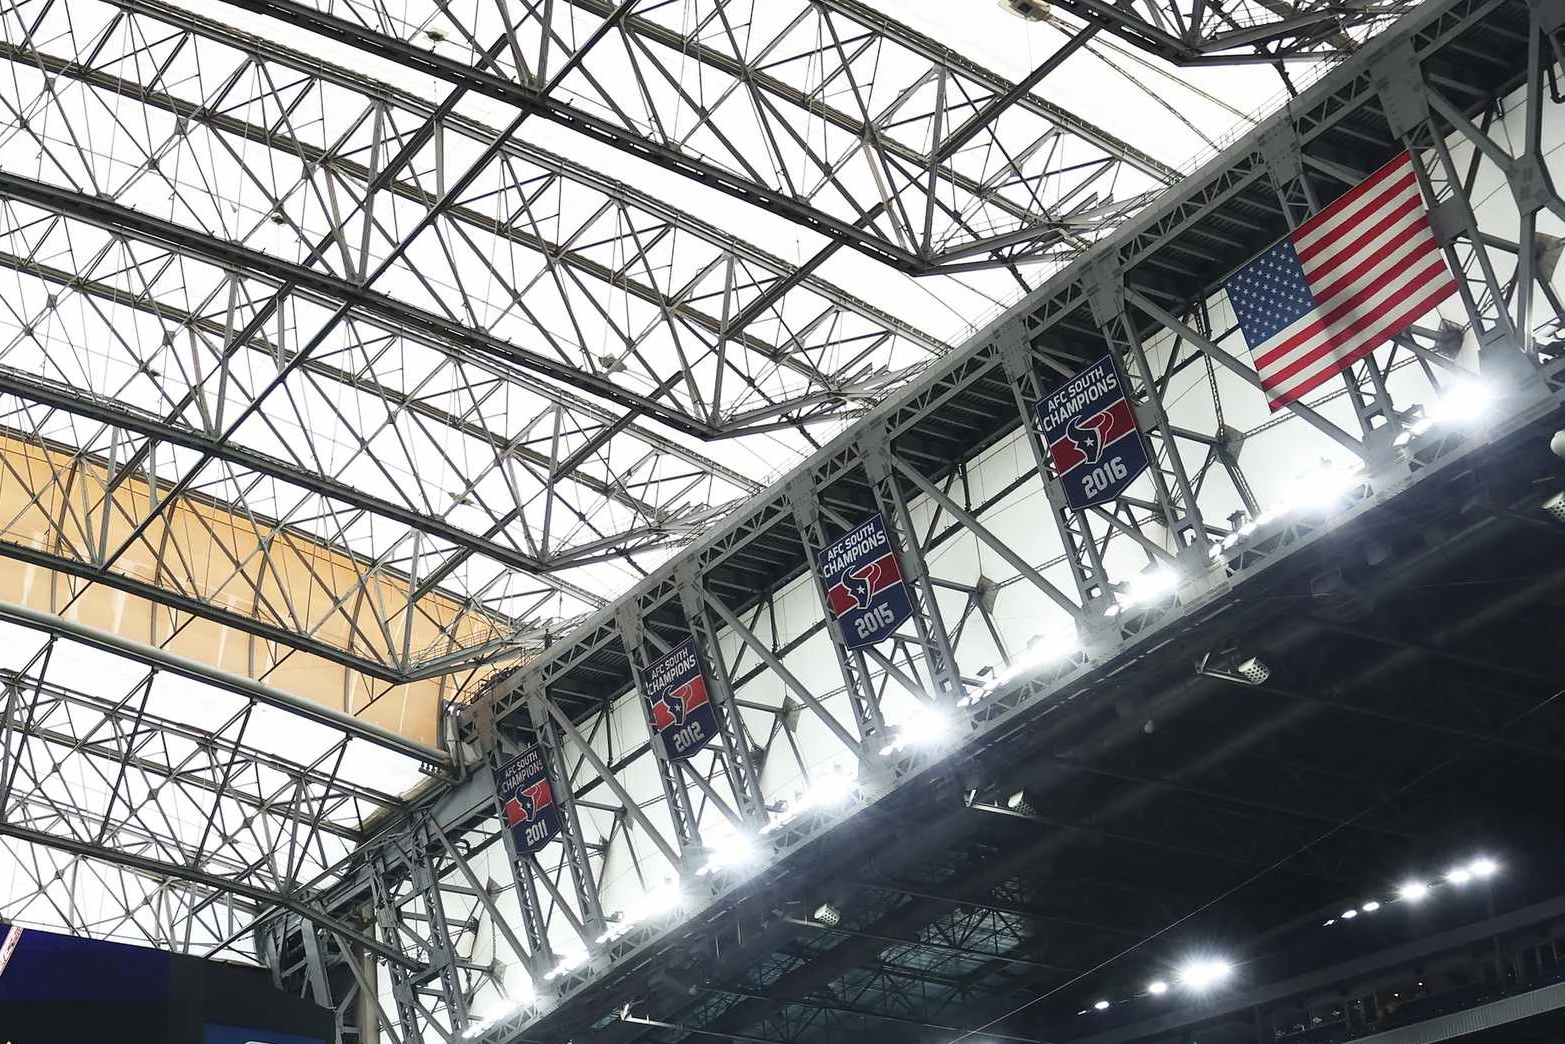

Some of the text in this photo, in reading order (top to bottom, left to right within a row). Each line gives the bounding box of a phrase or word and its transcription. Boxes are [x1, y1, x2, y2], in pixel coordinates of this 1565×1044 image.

[1043, 373, 1117, 432] CHAMPIONS
[1047, 366, 1104, 412] AFC SOUTH
[1082, 456, 1128, 499] 2016
[823, 531, 886, 578] CHAMPIONS
[828, 523, 875, 561] AFC SOUTH
[854, 602, 895, 640] 2015
[646, 655, 696, 696] CHAMPIONS
[652, 647, 689, 679] AFC SOUTH
[674, 721, 705, 753] 2012
[505, 750, 538, 778] AFC SOUTH
[525, 819, 548, 846] 2011
